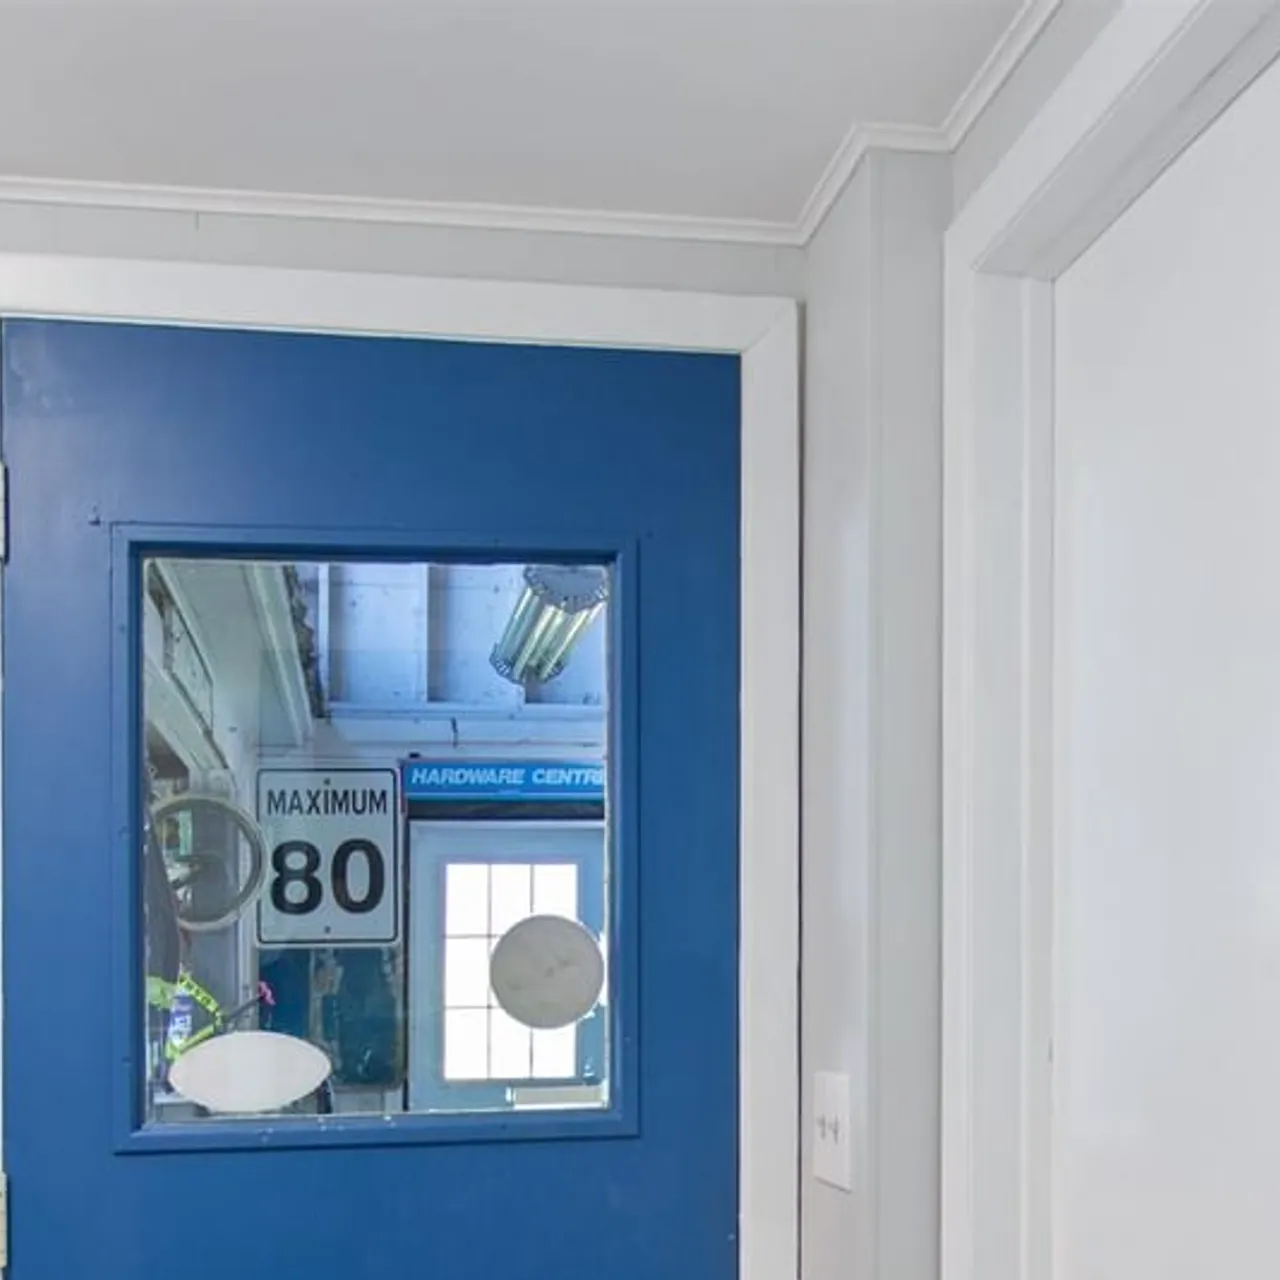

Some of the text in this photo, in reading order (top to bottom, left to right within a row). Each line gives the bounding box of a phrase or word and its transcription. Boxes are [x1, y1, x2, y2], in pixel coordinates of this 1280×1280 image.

[412, 767, 526, 785] HARDWARE
[266, 789, 388, 816] MAXIMUM
[271, 838, 386, 916] 80
